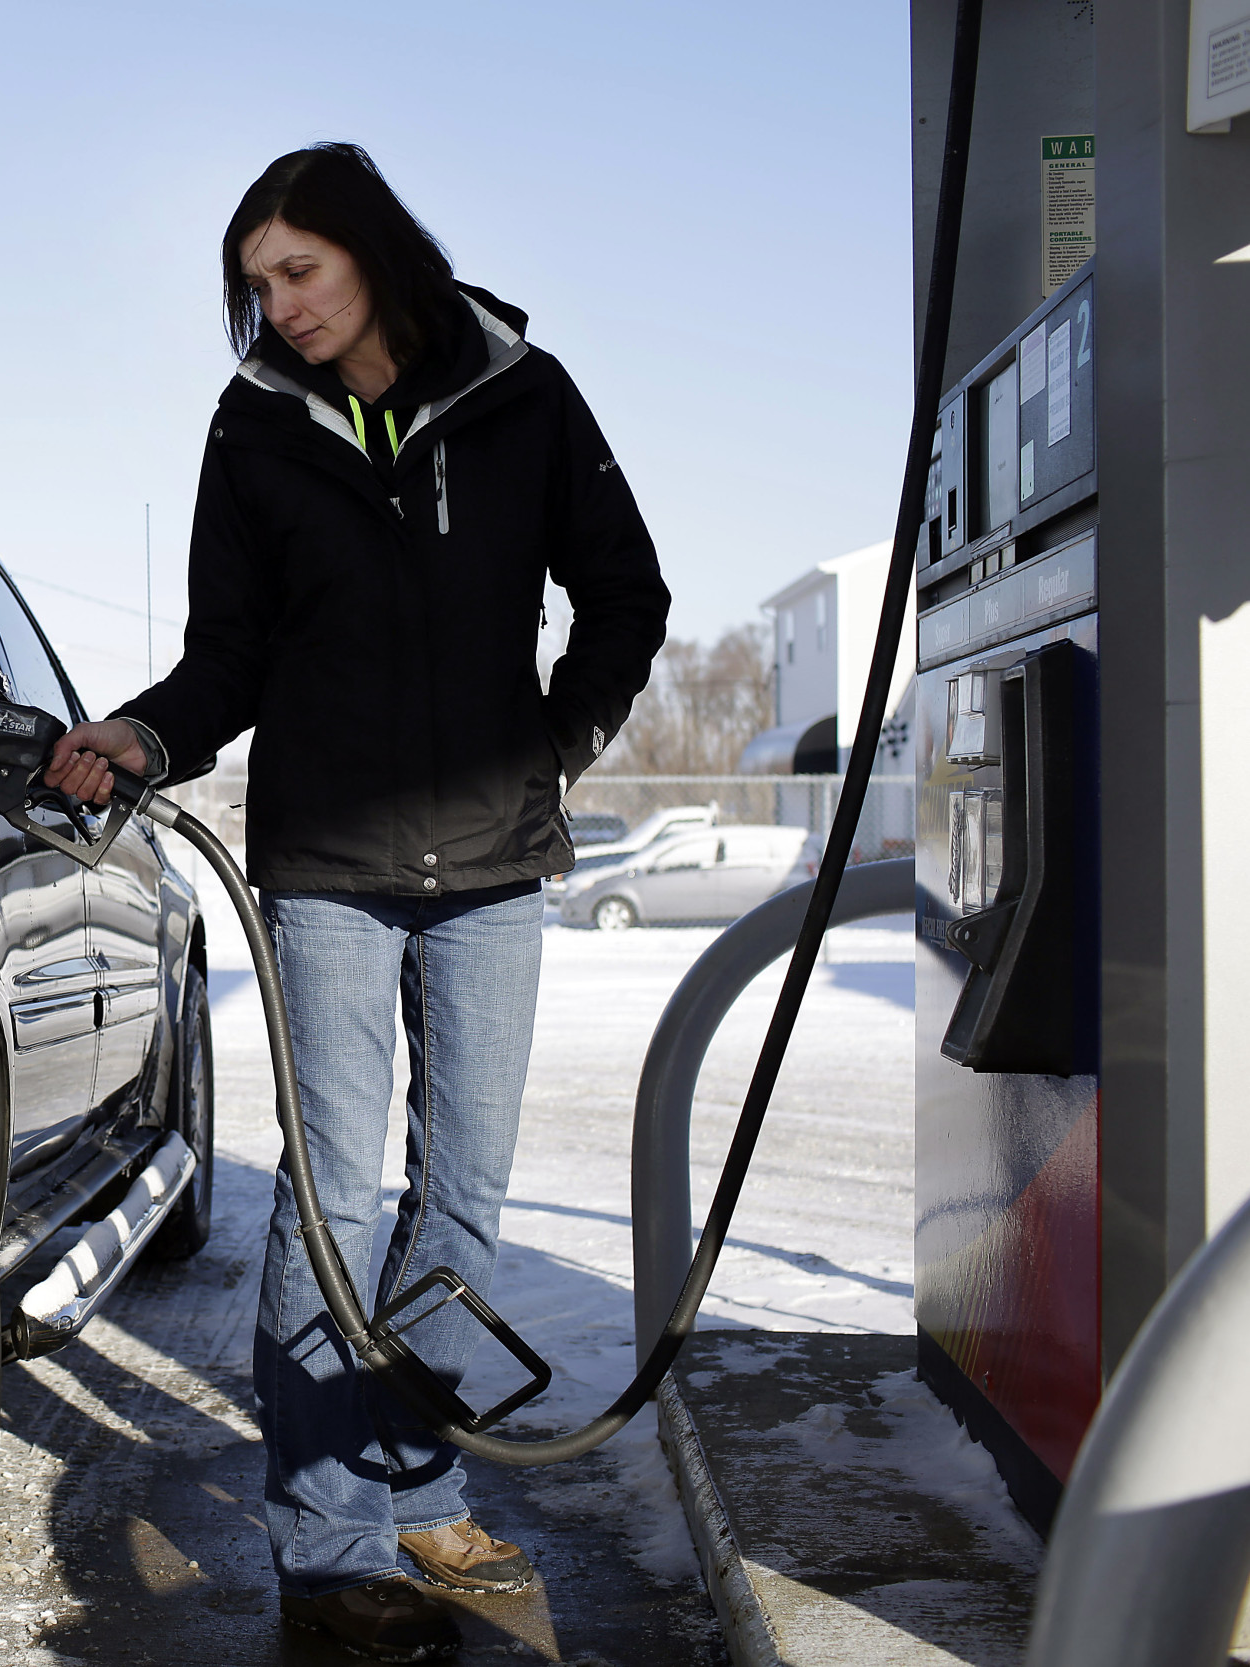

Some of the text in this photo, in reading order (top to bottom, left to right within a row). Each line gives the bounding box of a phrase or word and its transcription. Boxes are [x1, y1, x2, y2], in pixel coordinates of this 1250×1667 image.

[1077, 299, 1091, 369] 2
[1038, 566, 1069, 605] Regular
[984, 597, 1000, 626] Plus
